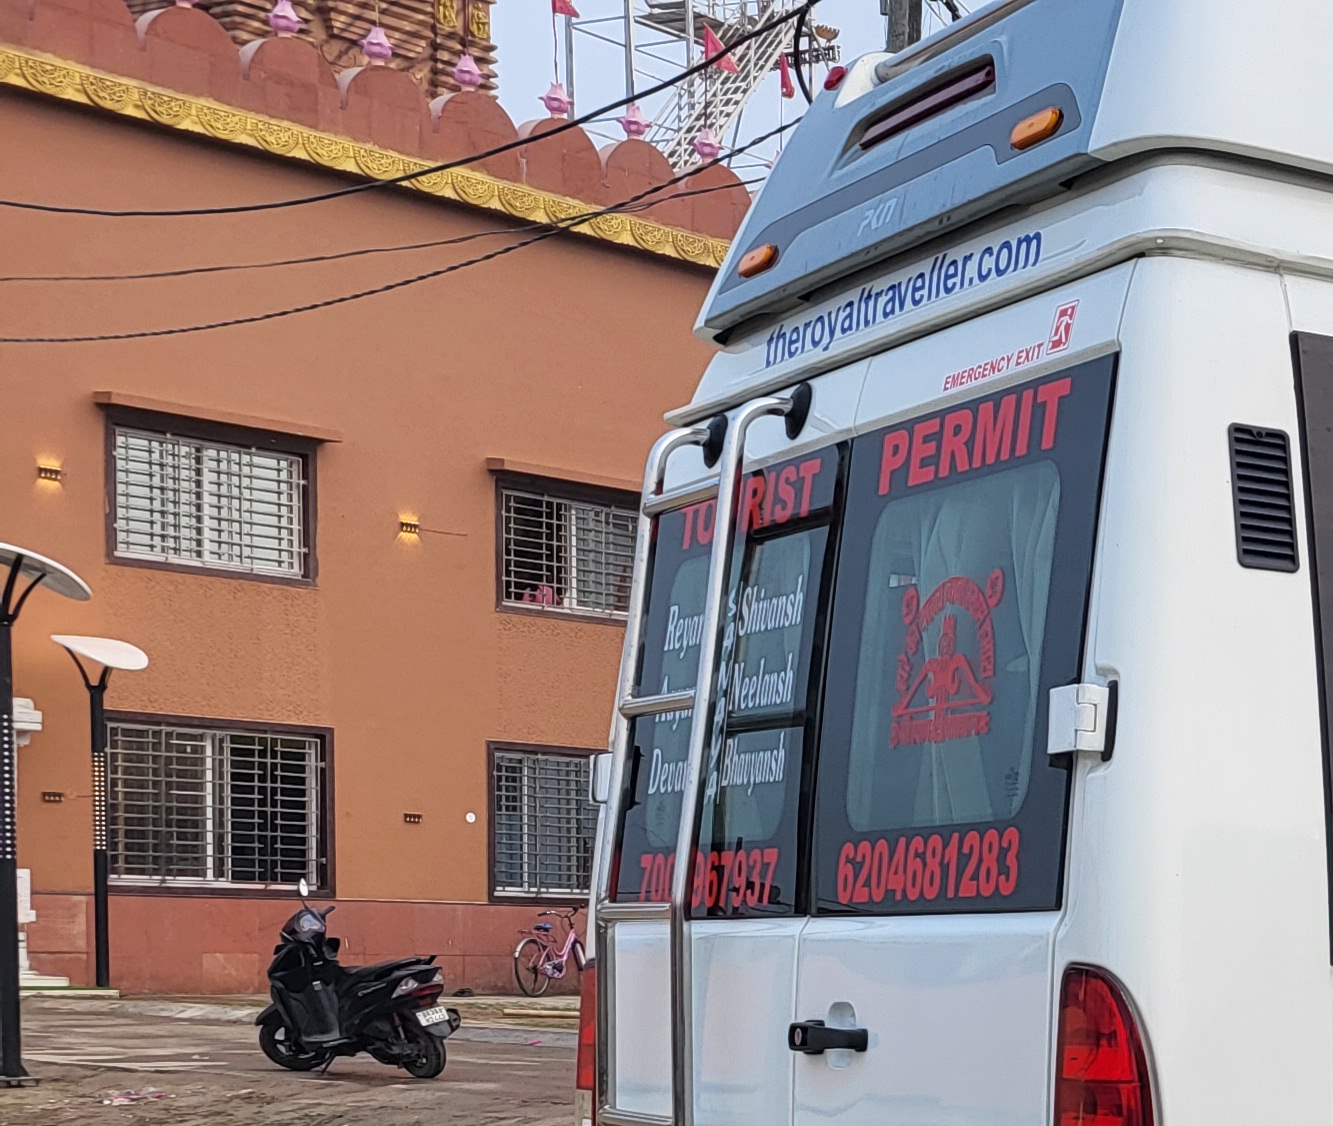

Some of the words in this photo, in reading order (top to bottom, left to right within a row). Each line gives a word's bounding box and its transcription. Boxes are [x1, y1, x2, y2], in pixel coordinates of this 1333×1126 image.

[765, 230, 1043, 368] theroyaltraveller.com
[943, 352, 1014, 392] EMERGENCY
[1015, 341, 1045, 367] EXIT
[680, 458, 822, 550] TORIST
[878, 377, 1072, 496] PERMIT
[738, 574, 804, 637] Shivansh
[729, 652, 794, 711] Neelansh
[720, 731, 786, 796] Bhavyansh
[837, 826, 1020, 905] 6204681283
